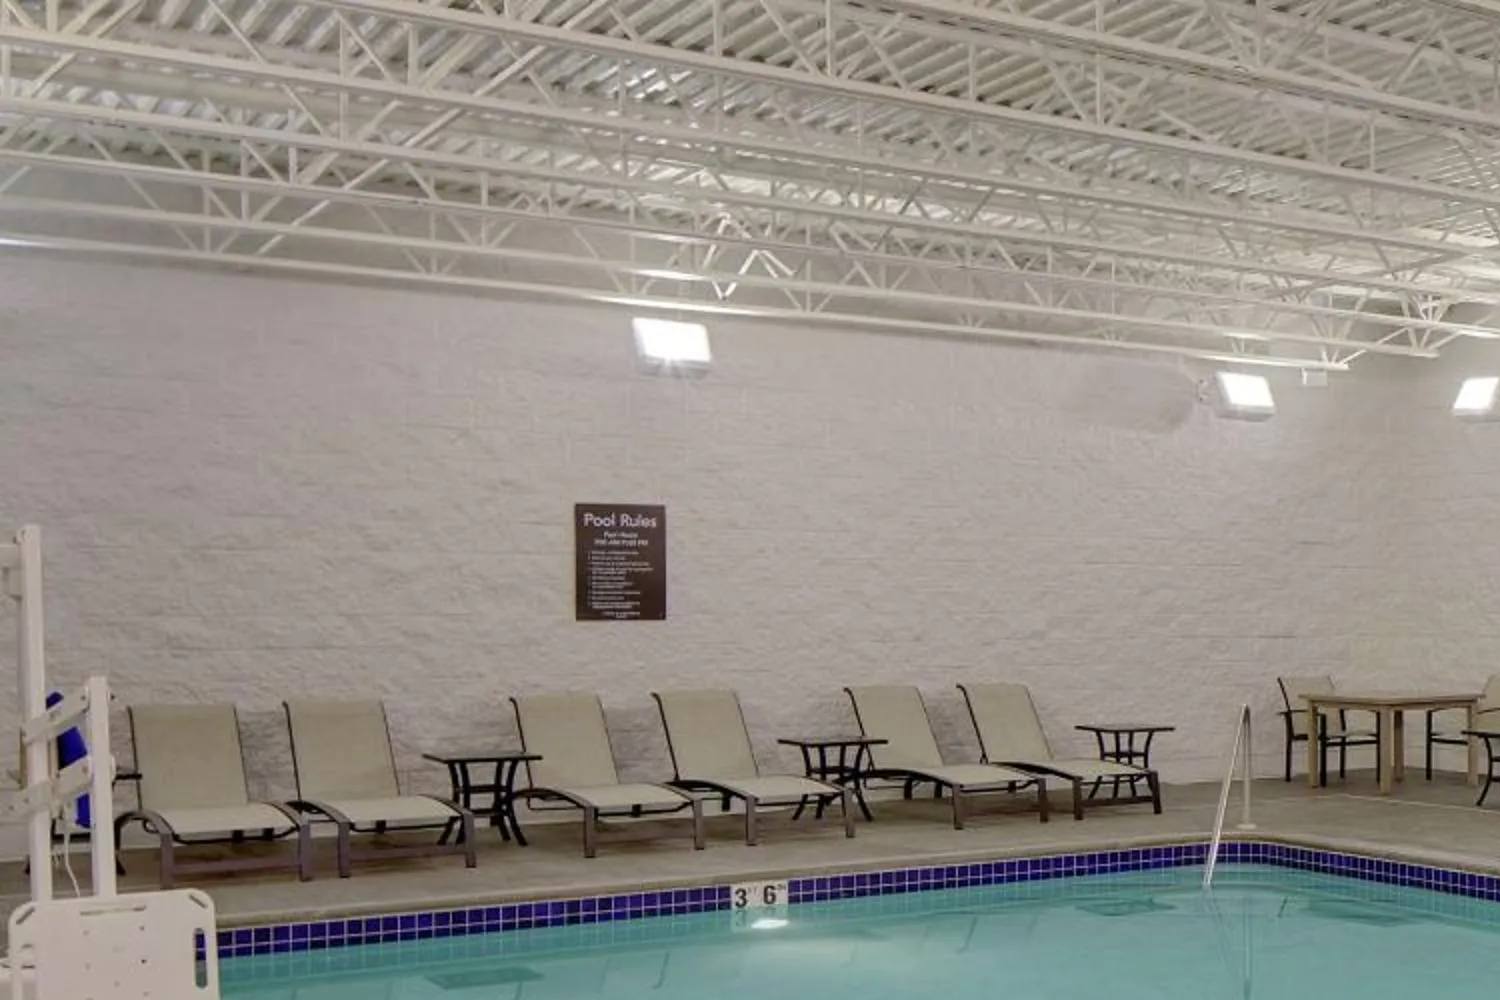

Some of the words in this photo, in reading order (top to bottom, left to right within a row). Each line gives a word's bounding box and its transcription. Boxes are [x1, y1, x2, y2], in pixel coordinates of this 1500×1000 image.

[583, 513, 616, 527] Pool
[620, 513, 657, 528] Rules
[735, 887, 748, 908] 3
[763, 885, 776, 905] 6
